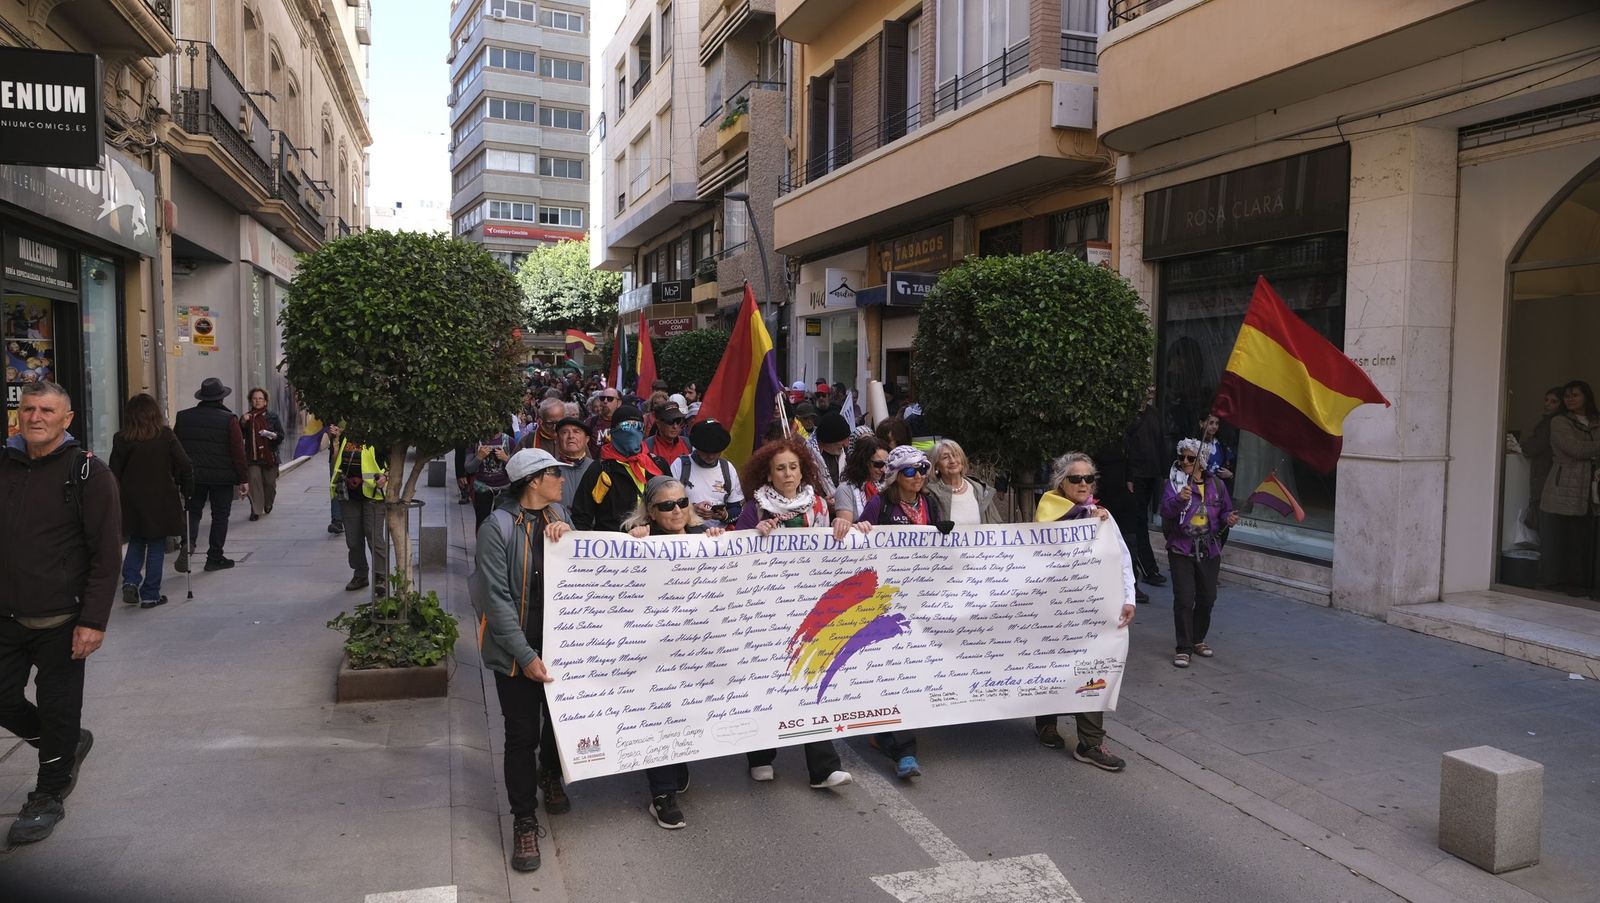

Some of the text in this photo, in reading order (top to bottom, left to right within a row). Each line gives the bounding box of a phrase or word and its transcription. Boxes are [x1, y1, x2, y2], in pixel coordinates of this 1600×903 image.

[1, 81, 86, 113] ENIUM
[1, 120, 87, 132] NIUMCOMICS.ES
[1185, 206, 1226, 227] ROSA
[895, 236, 944, 260] TABACOS
[573, 524, 1098, 561] HOMENAJE A LAS MUJERES DE LA CARRETERA DE LA MUERTE
[983, 675, 1021, 688] tantas
[778, 704, 900, 730] ASC LA DESBANDÁ
